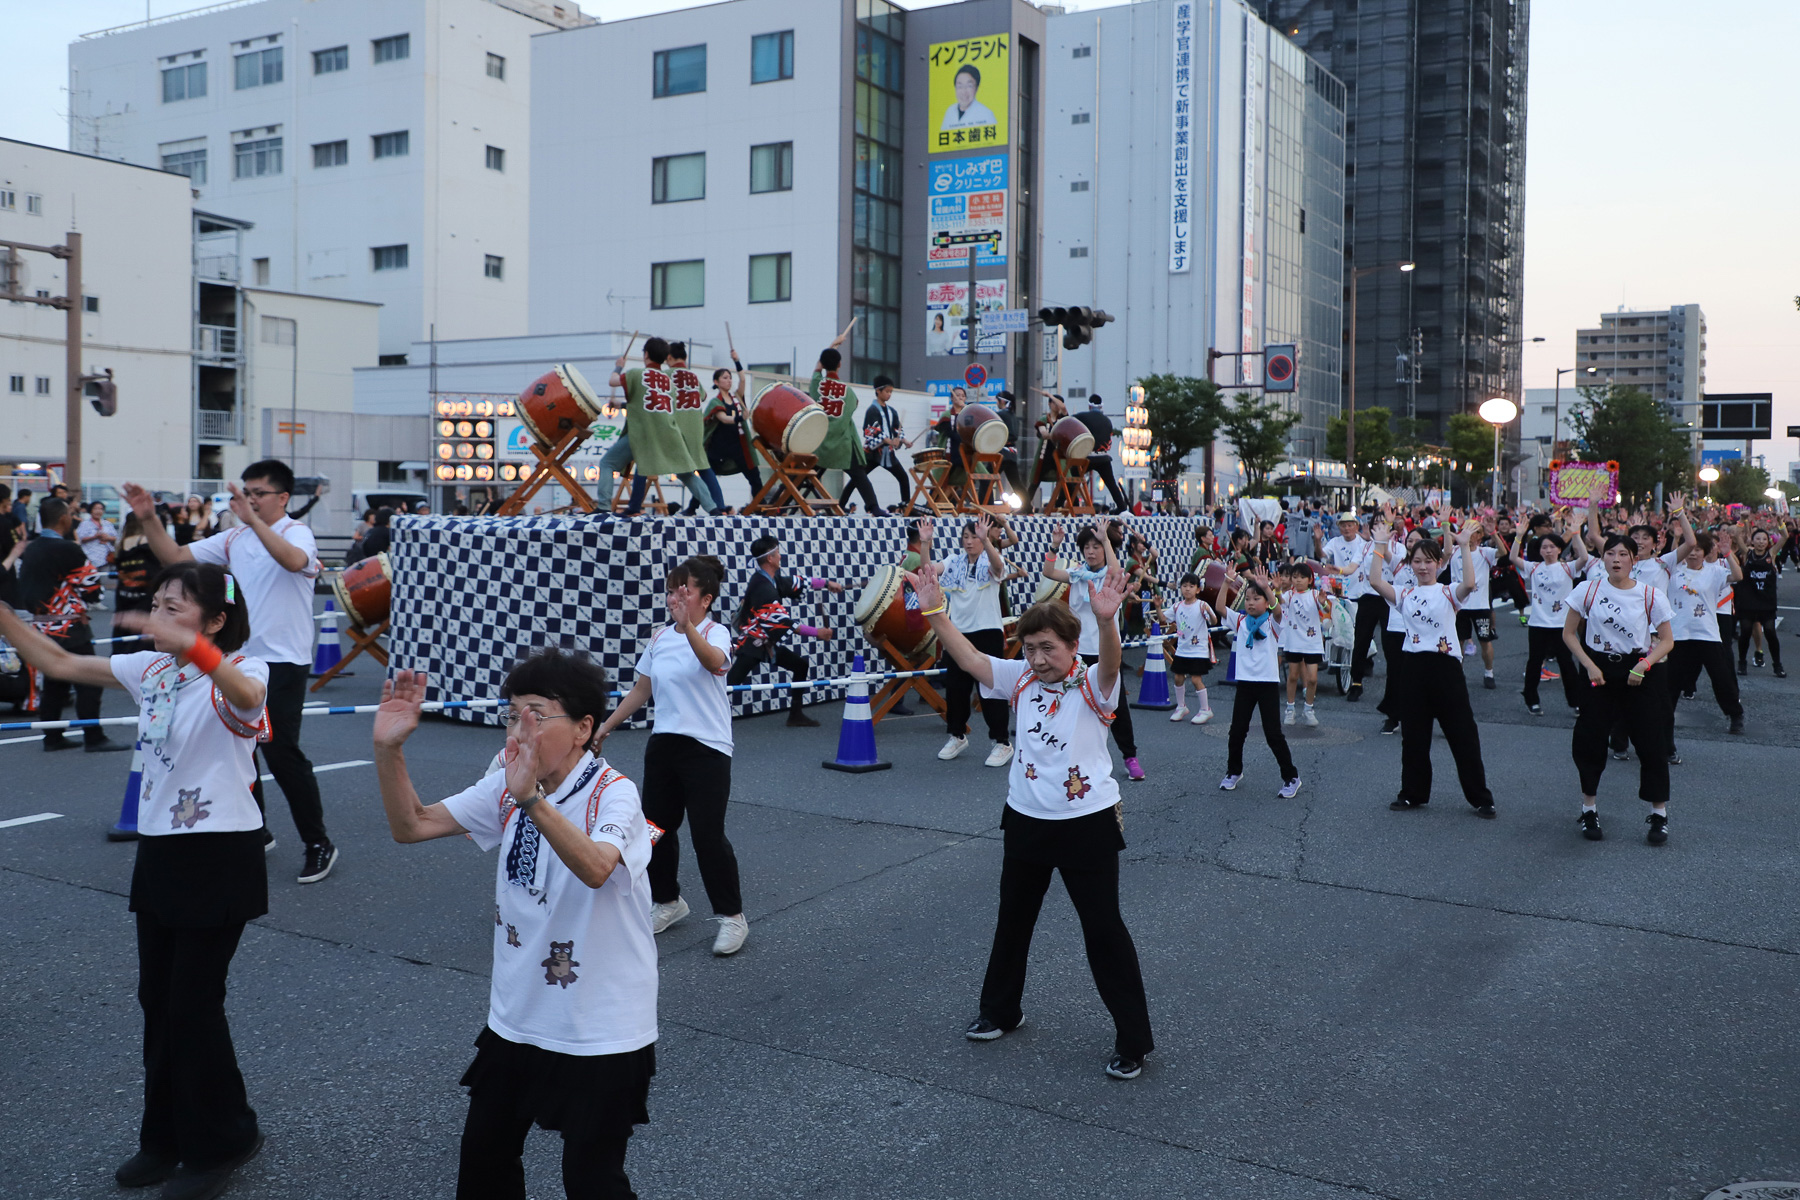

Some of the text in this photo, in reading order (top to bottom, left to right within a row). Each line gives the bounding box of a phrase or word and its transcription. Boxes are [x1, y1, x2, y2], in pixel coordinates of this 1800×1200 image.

[930, 37, 1007, 66] インプラント
[938, 125, 997, 146] 日本歯科
[1174, 4, 1190, 270] 産学官連携で新事業創出を支援します
[954, 158, 1003, 178] しみず巴
[954, 175, 1002, 190] クリニック
[928, 282, 1005, 302] お売りさい!
[642, 368, 673, 414] 押切
[672, 368, 701, 410] 押切
[818, 377, 847, 417] 押切
[1756, 581, 1765, 590] 12
